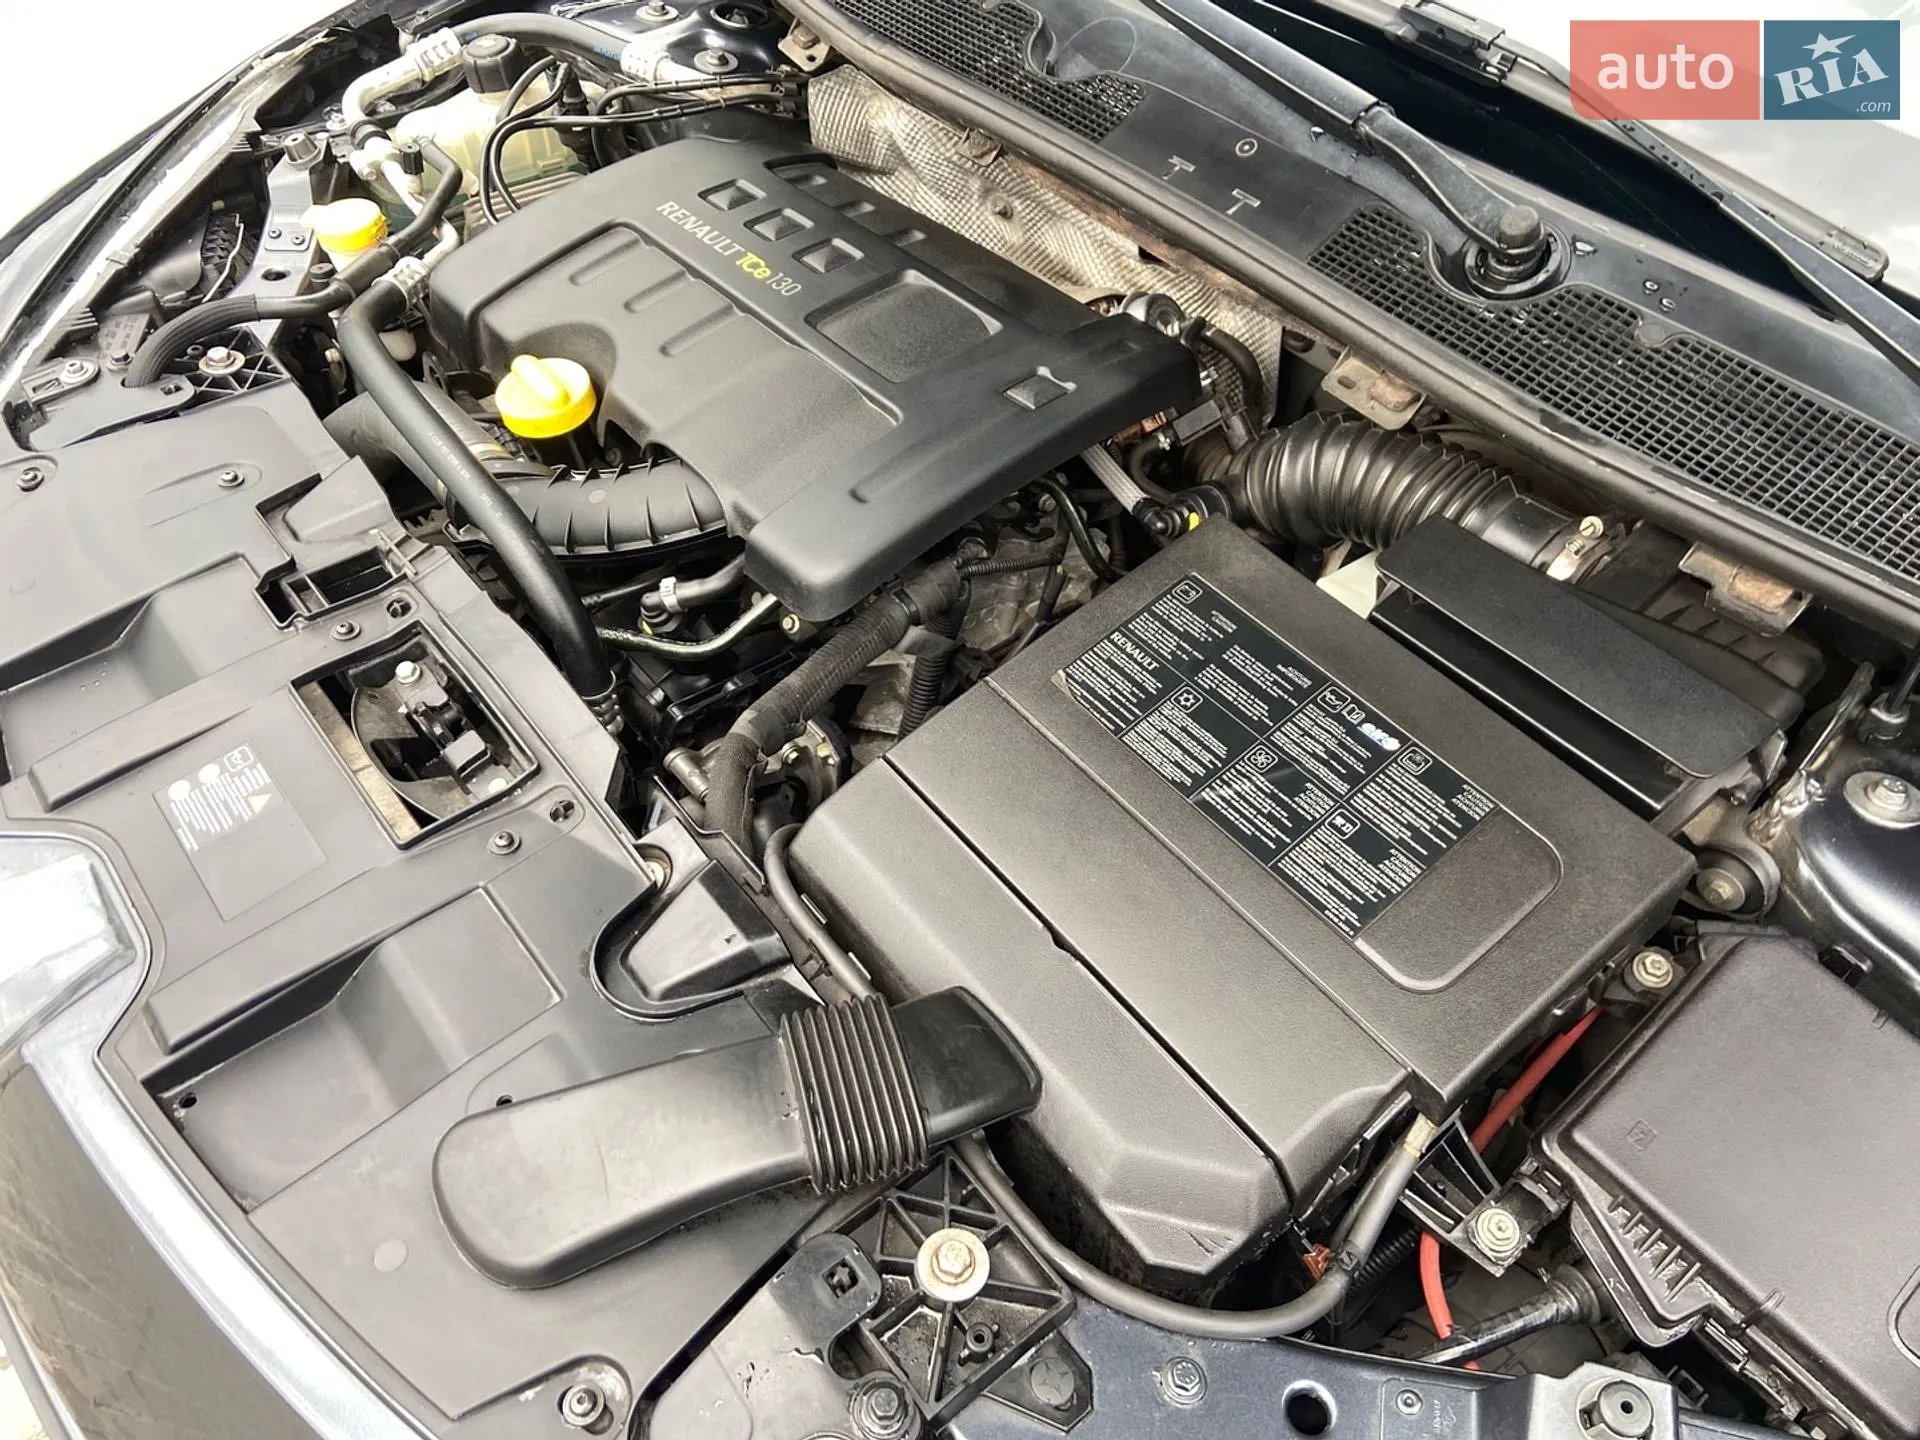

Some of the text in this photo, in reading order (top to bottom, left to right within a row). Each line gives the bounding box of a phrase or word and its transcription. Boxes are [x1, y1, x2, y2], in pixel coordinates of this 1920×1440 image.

[656, 201, 802, 296] RENAULT TCe 130
[1109, 631, 1160, 671] RENAULT
